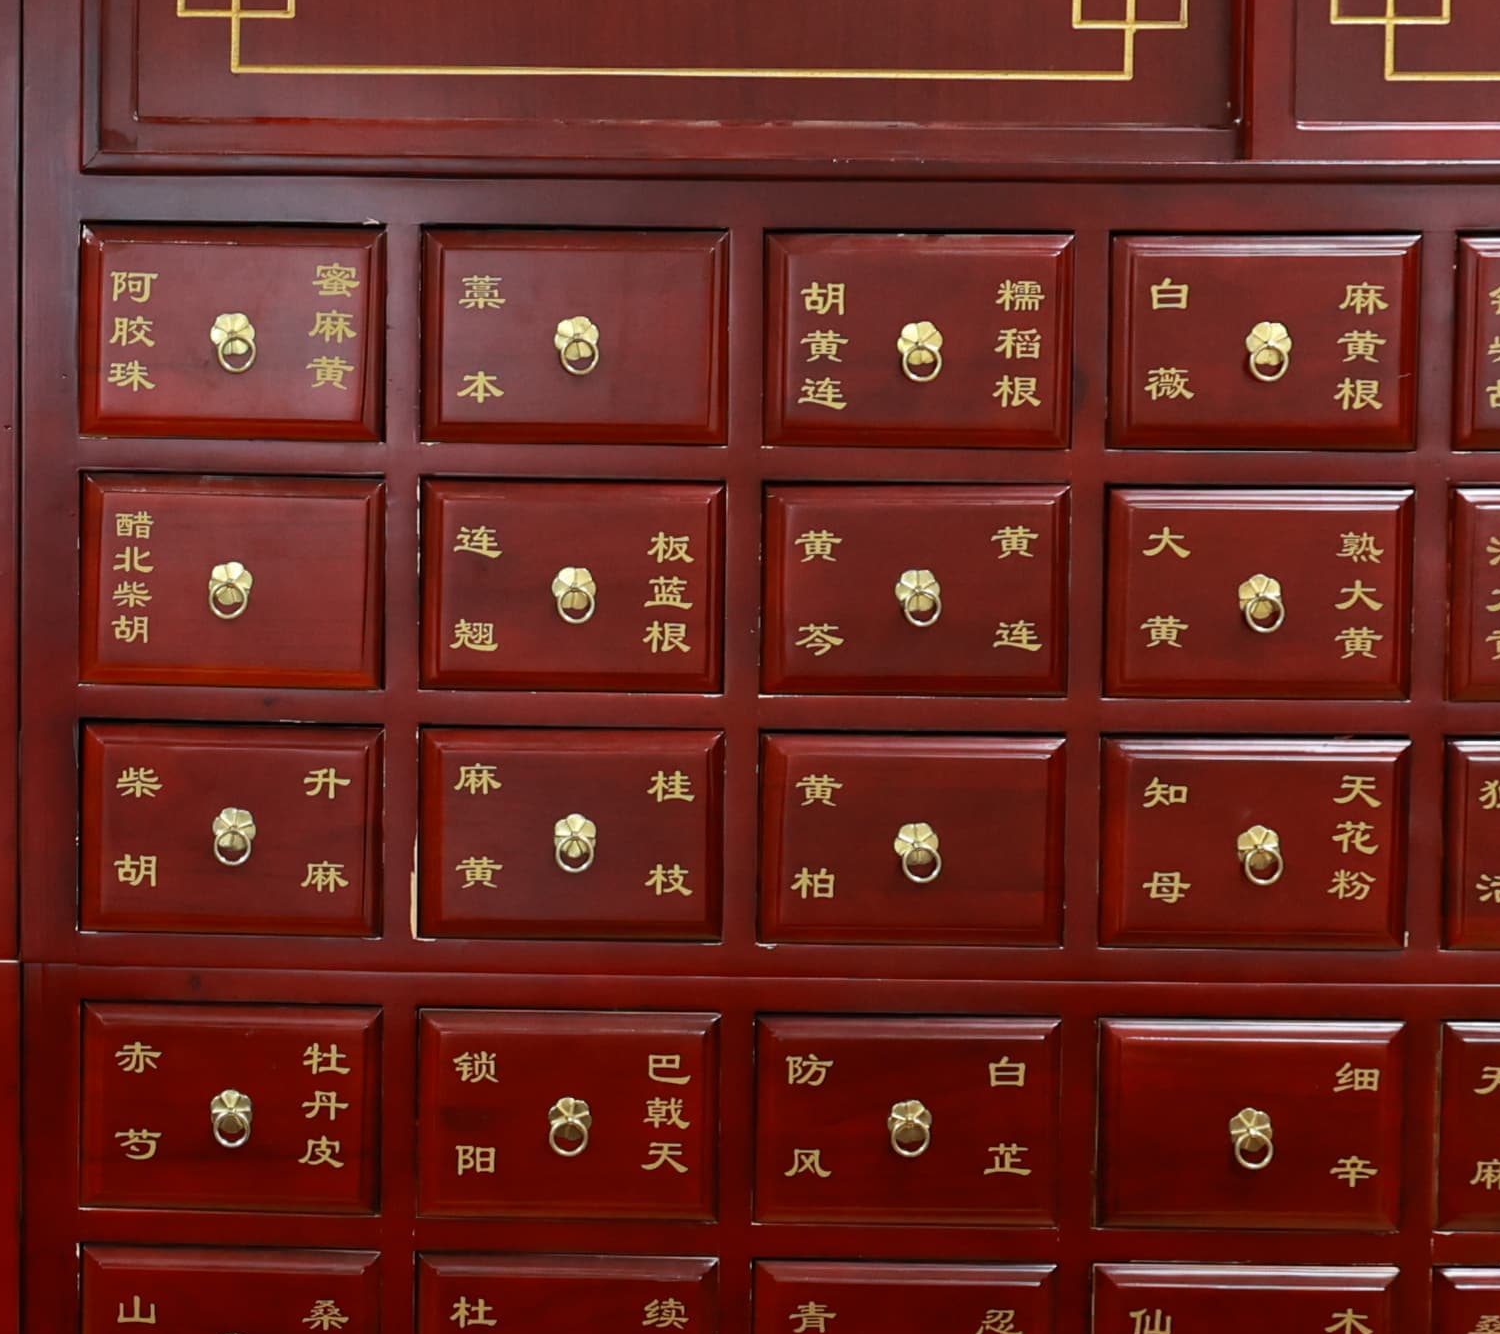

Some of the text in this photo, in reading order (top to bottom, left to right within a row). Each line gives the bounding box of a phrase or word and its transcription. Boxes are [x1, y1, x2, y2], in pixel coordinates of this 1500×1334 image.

[106, 270, 159, 391] 阿胶珠
[307, 262, 362, 391] 蜜麻黄
[799, 281, 850, 412] 胡黄连
[991, 279, 1047, 409] 糯稻根
[1334, 281, 1391, 412] 麻黄根
[112, 511, 155, 643] 醋北柴胡
[641, 530, 696, 654] 板蓝根
[1141, 525, 1193, 648] 大黄
[1334, 531, 1386, 660] 熟大黄
[1326, 773, 1383, 902] 天花粉
[298, 1042, 352, 1169] 牡丹皮
[641, 1053, 692, 1174] 巴戟天
